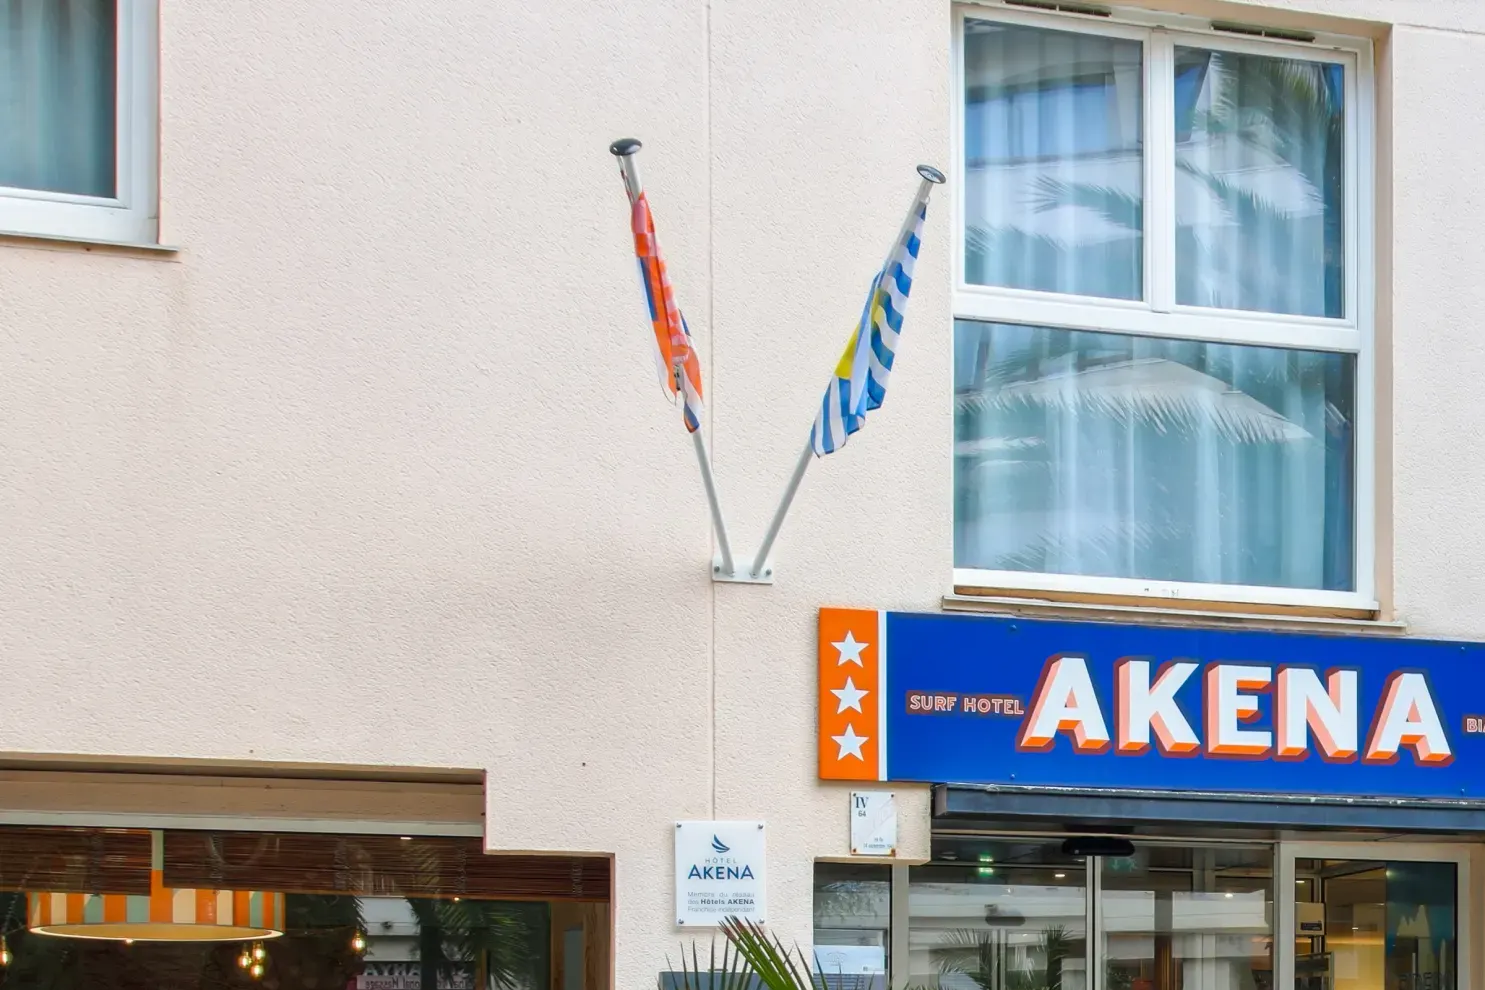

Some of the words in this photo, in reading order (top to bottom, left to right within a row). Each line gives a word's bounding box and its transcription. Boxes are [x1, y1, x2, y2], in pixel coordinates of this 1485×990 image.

[909, 694, 958, 712] SURF
[963, 696, 1026, 716] HOTEL
[1017, 655, 1454, 766] AKENA
[687, 864, 755, 880] AKENA
